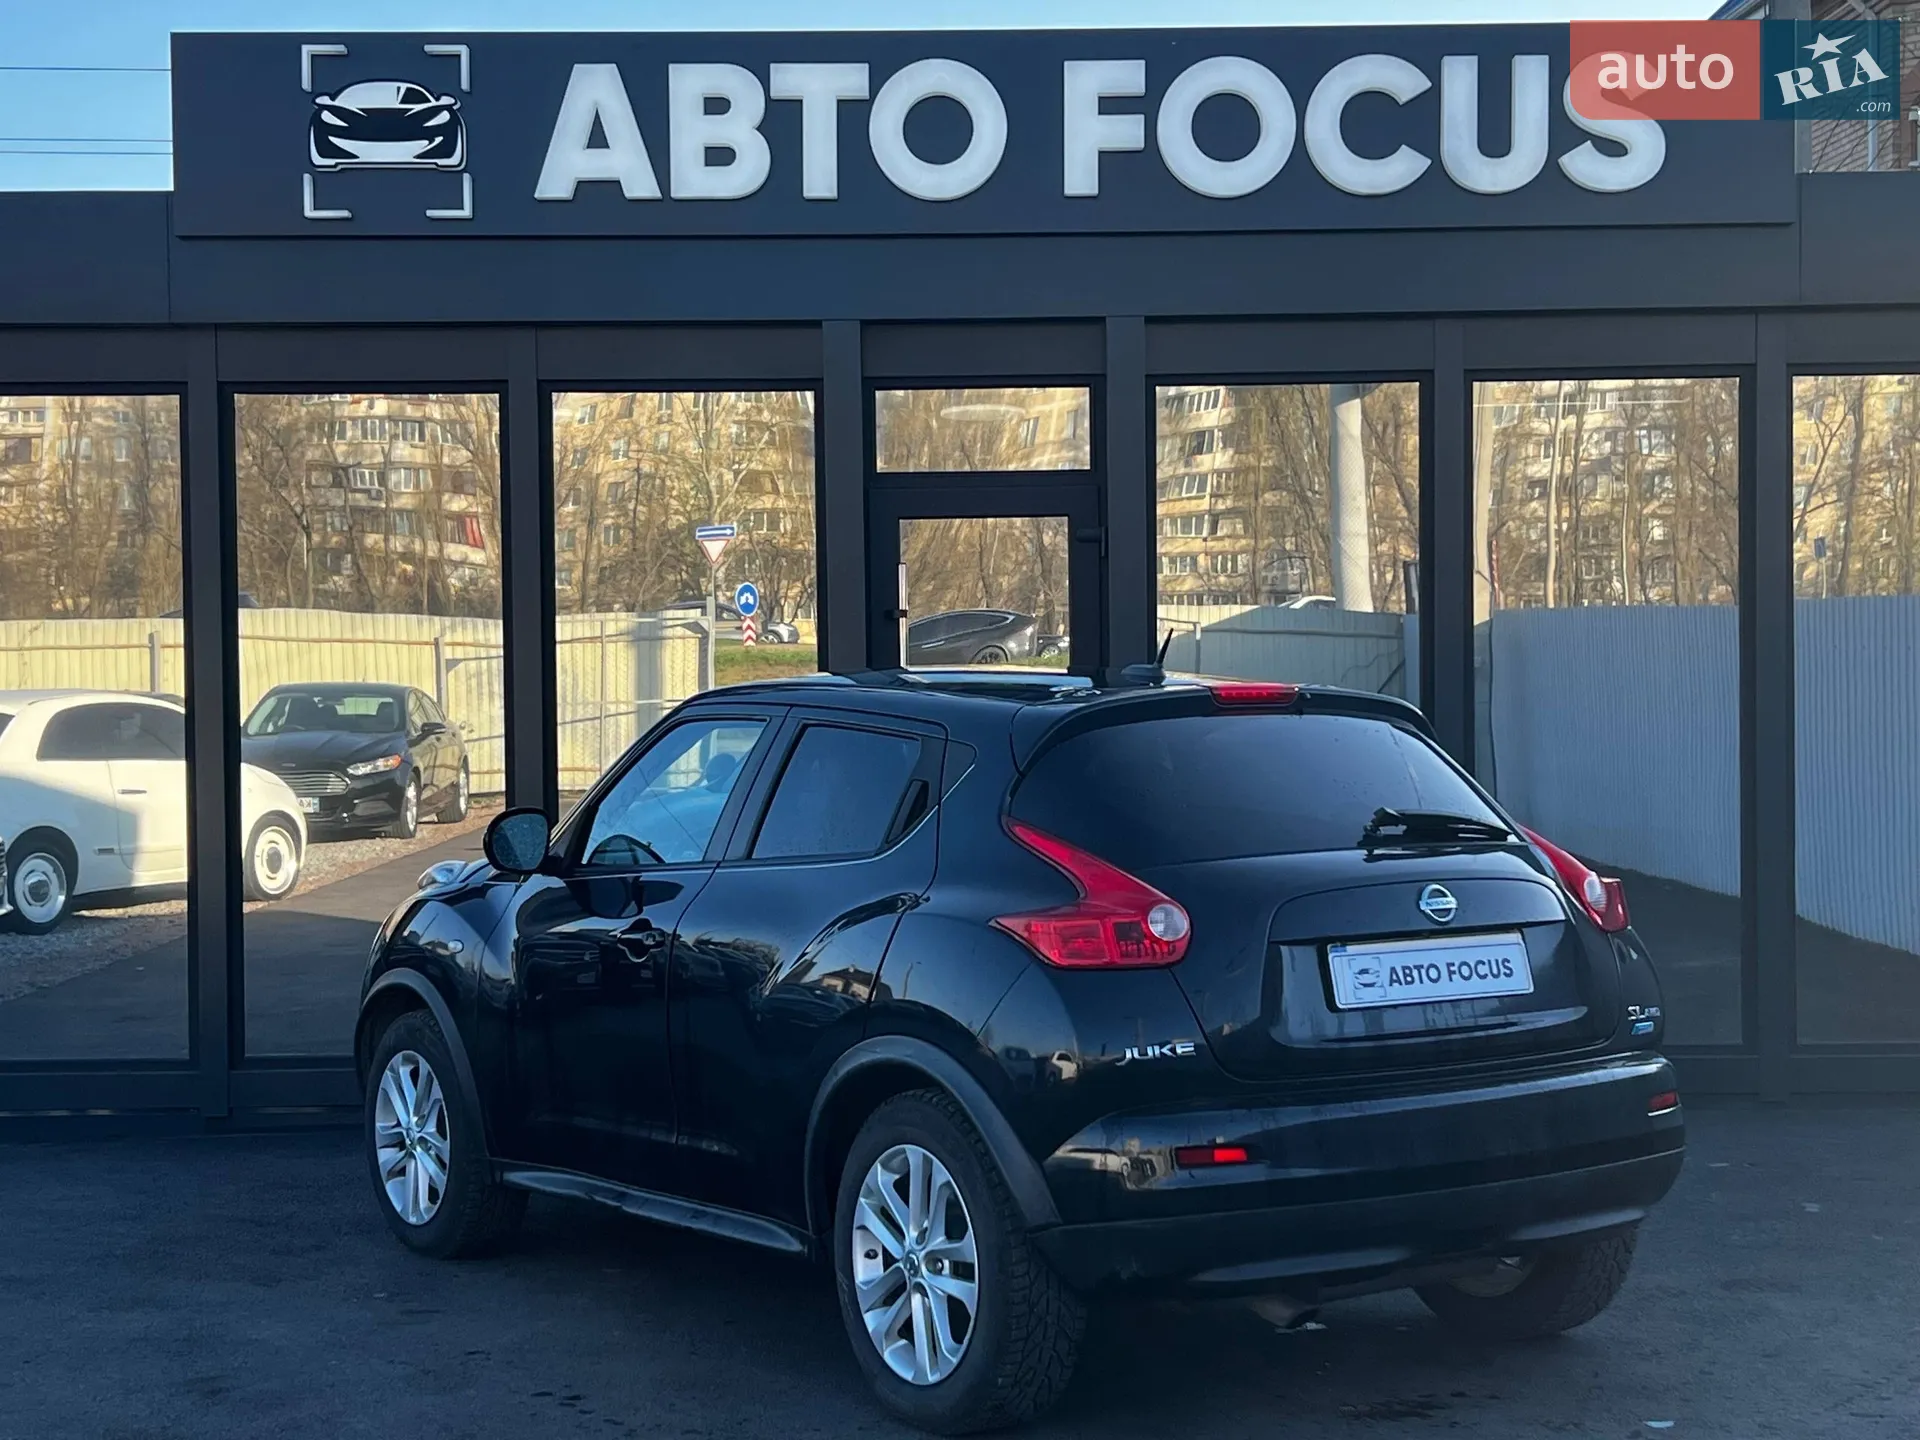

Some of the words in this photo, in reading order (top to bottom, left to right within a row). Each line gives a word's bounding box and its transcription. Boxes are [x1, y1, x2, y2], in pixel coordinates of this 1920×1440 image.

[533, 57, 1009, 202] АВТО
[1062, 51, 1668, 200] FOCUS
[1388, 962, 1442, 988] АВТО
[1447, 956, 1514, 983] FOCUS
[1115, 1042, 1197, 1067] JUKE
